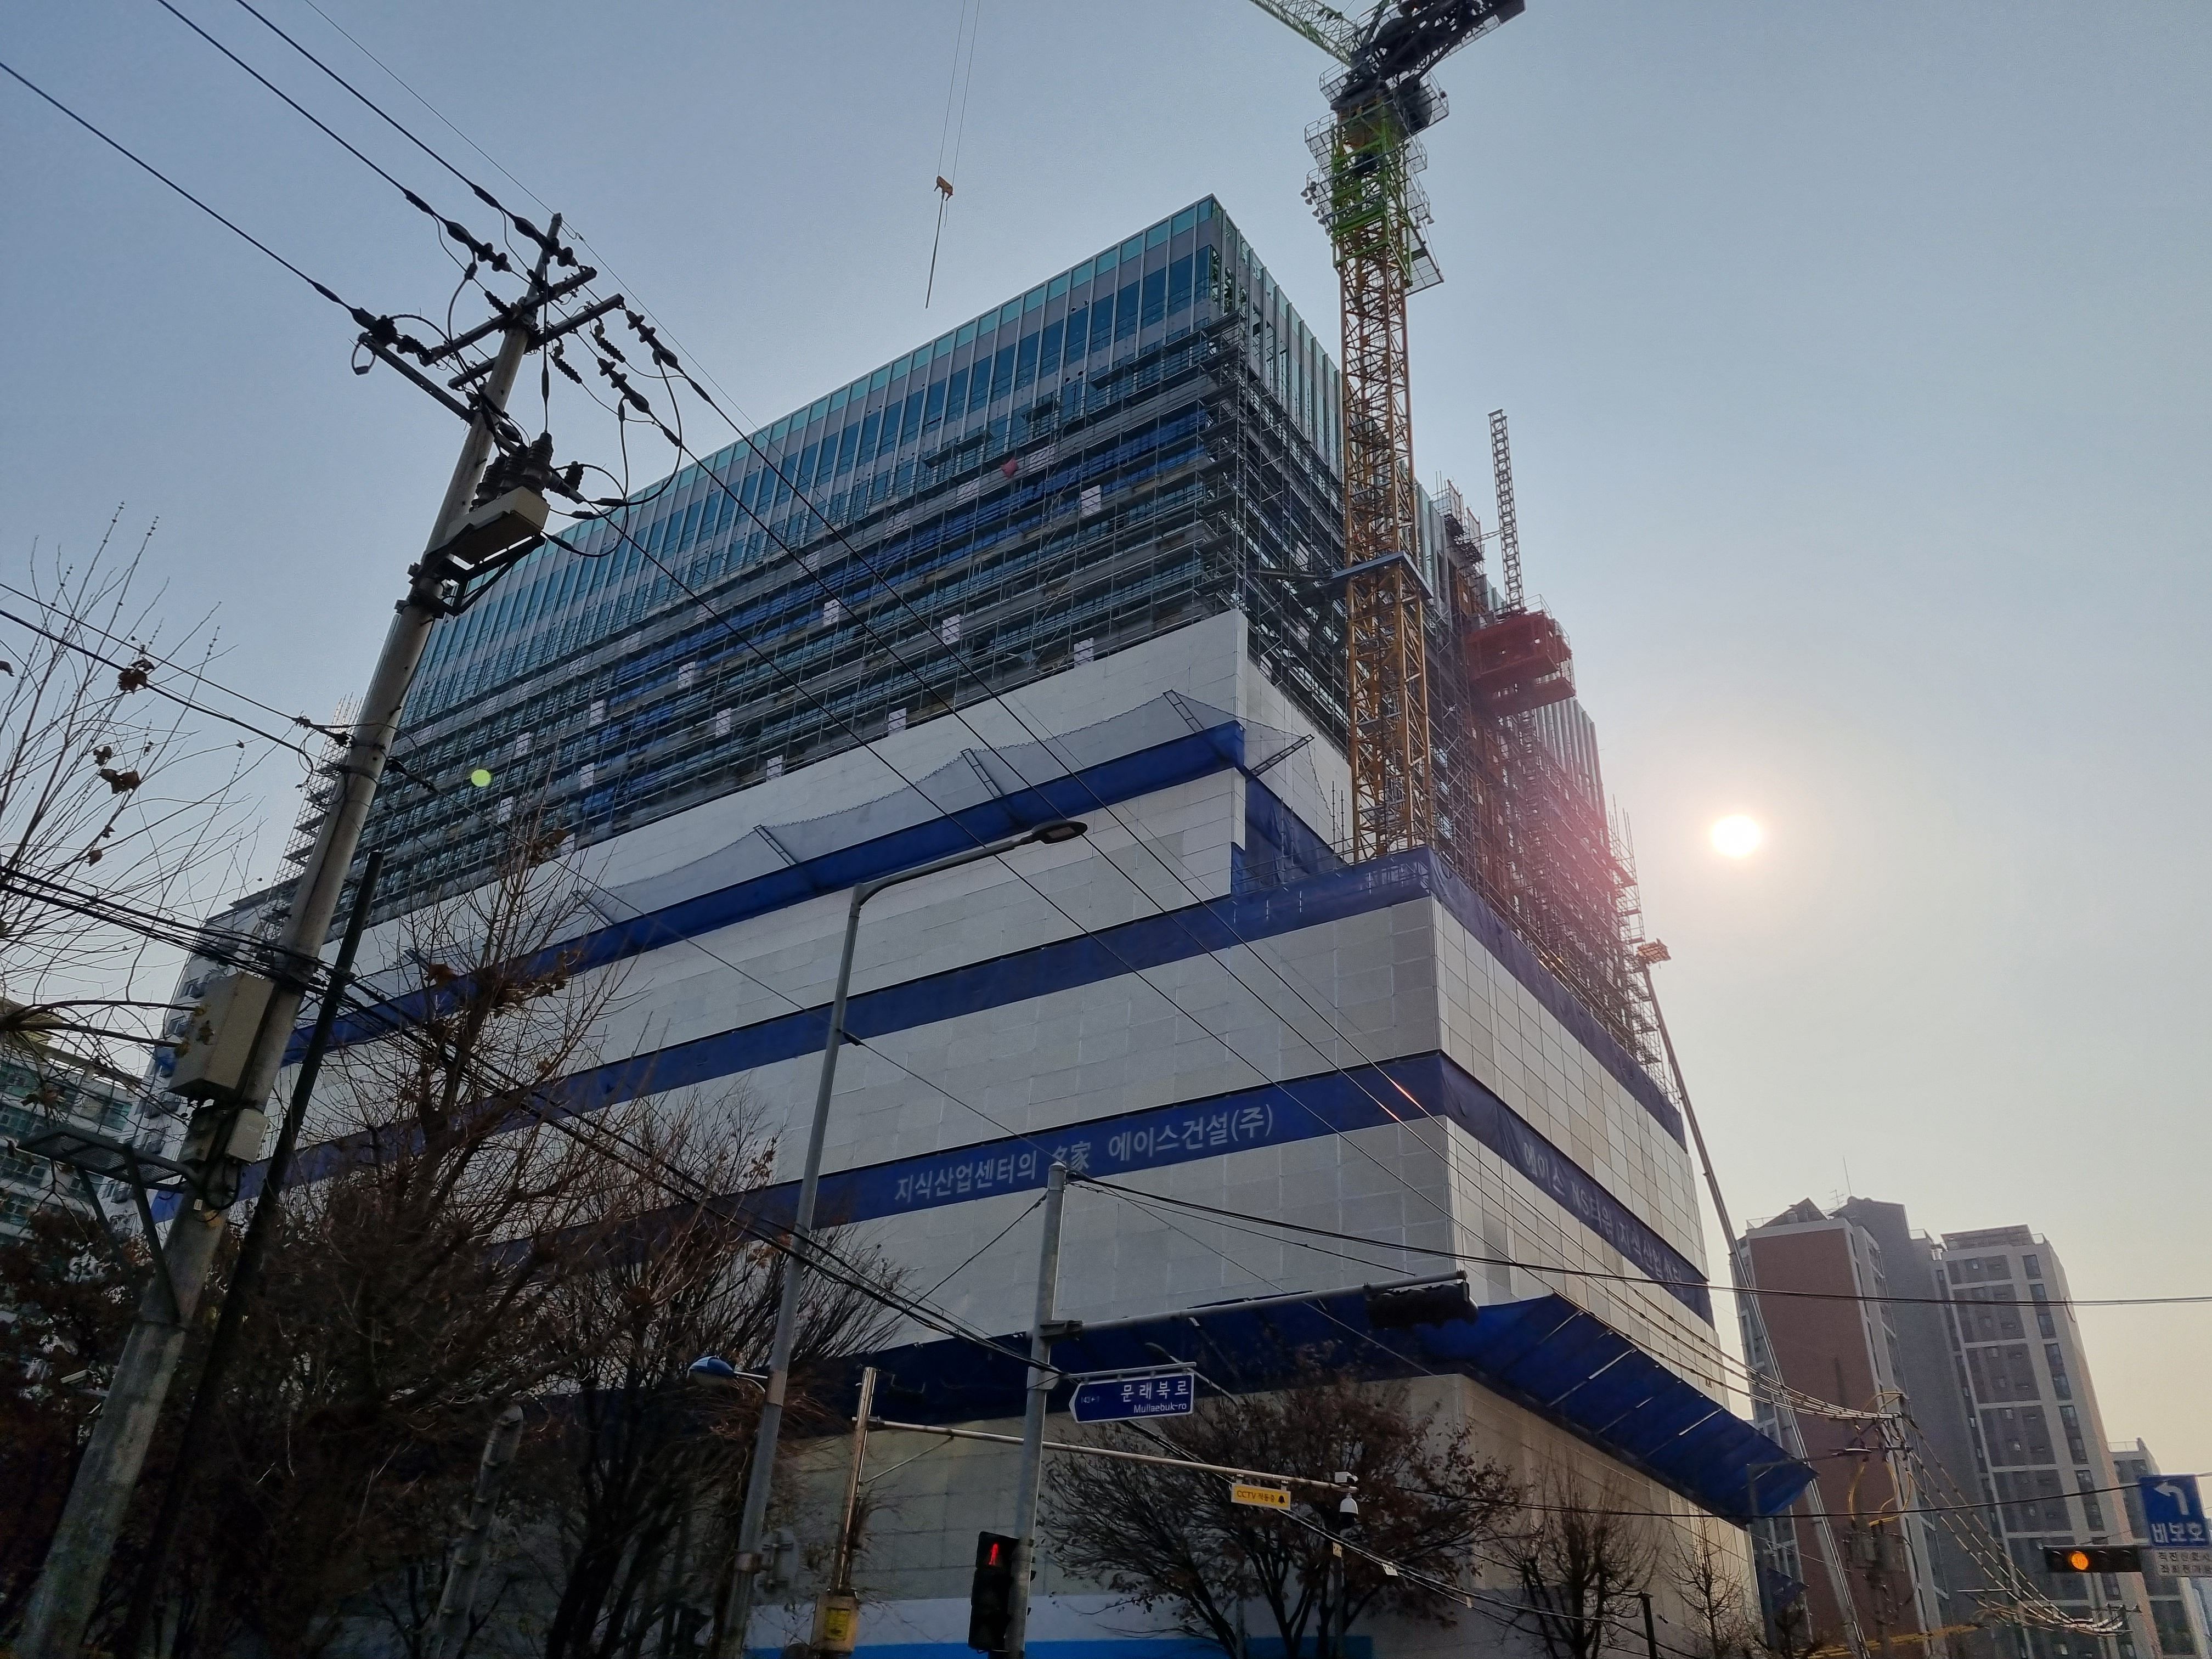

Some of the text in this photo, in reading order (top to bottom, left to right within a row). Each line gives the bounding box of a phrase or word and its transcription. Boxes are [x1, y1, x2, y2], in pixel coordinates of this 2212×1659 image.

[894, 1150, 1036, 1204] 지식산업센터의
[1108, 1104, 1274, 1162] 에이스건설(주)
[1523, 1142, 1565, 1196] 에이스
[1120, 1380, 1189, 1402] 문래북로
[1133, 1401, 1187, 1414] Mullaebuk-ro
[1237, 1490, 1256, 1499] CCTV
[2151, 1522, 2205, 1543] 비보호
